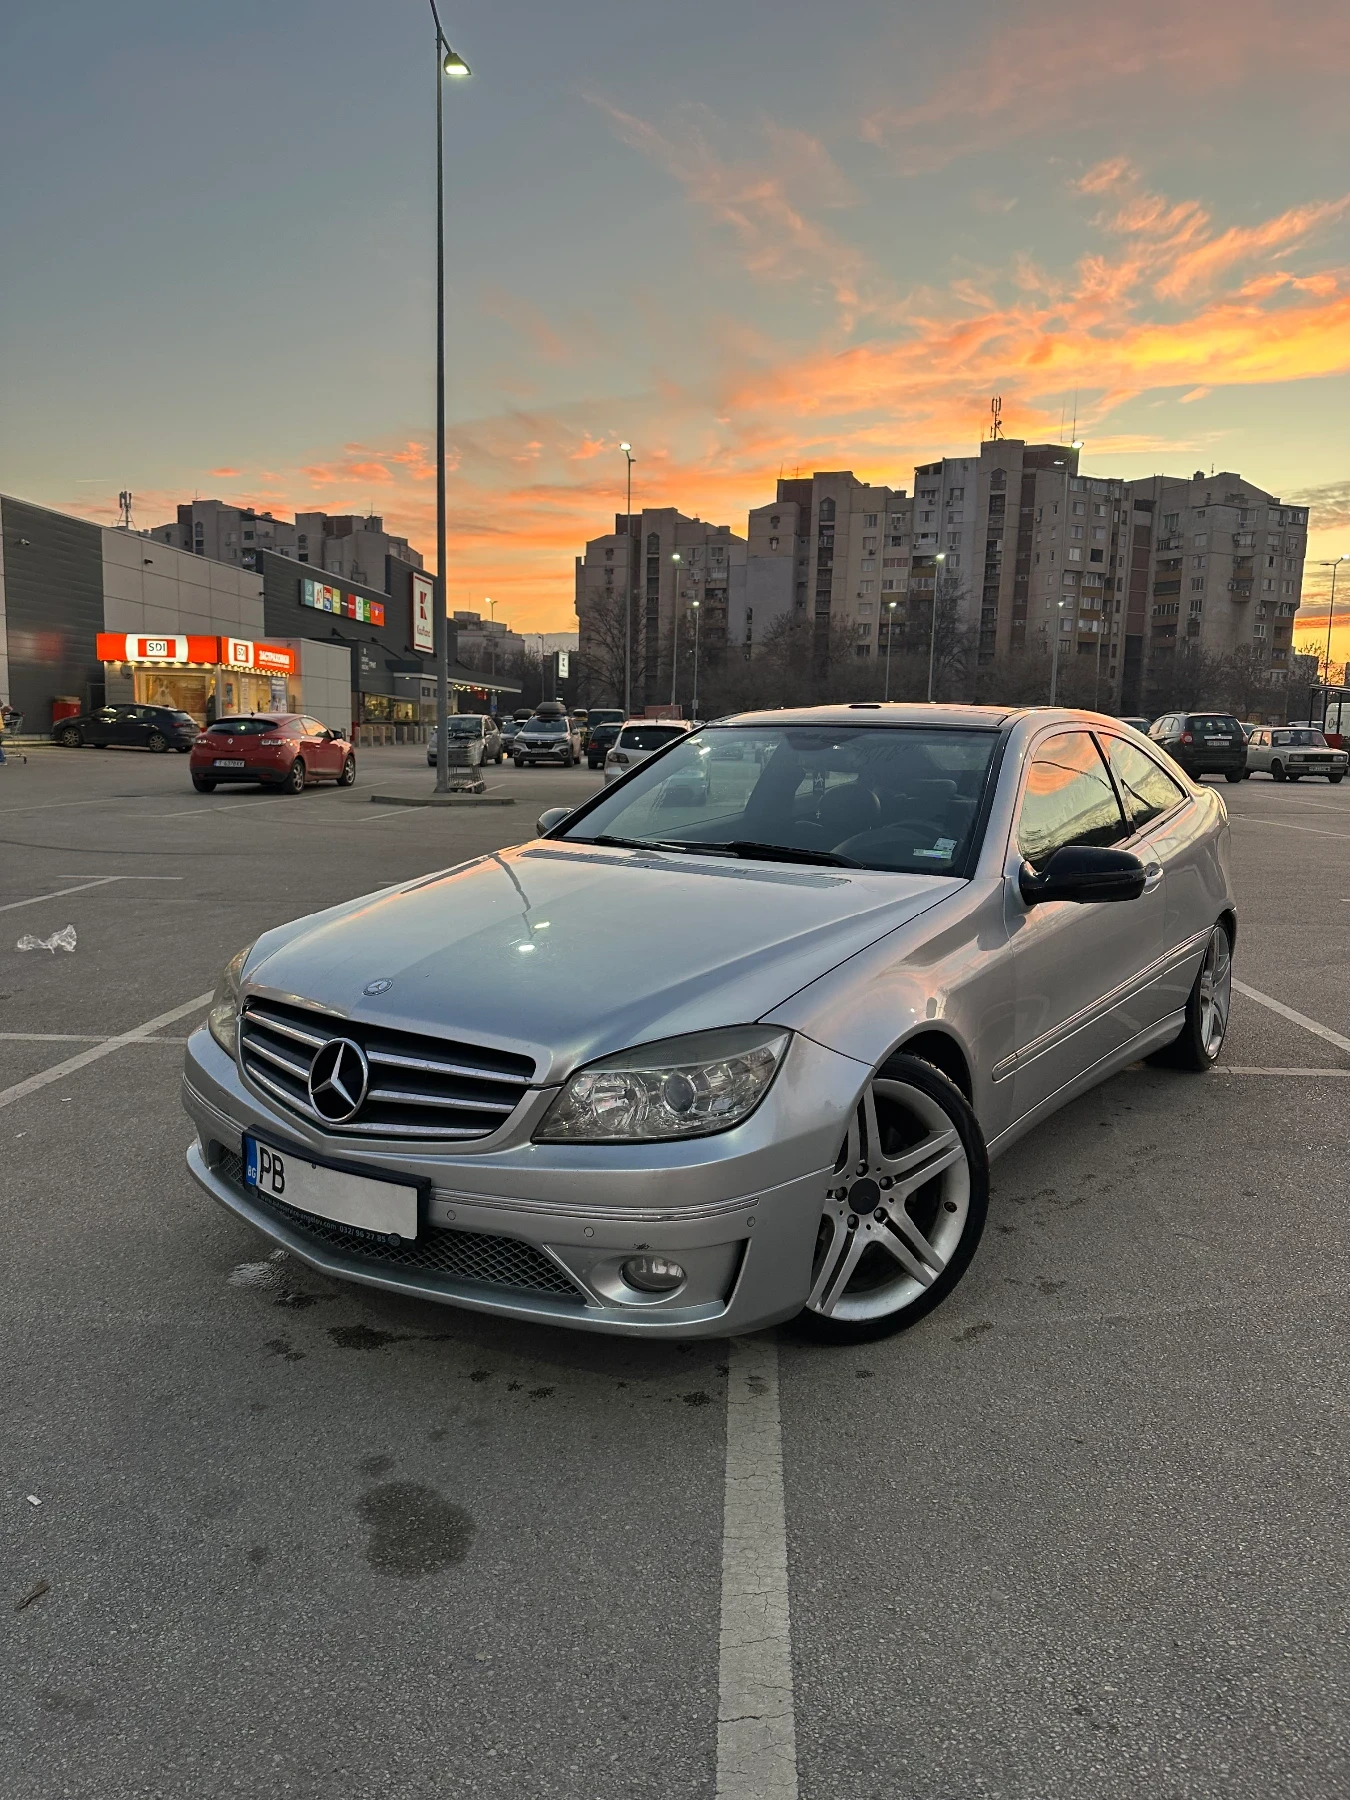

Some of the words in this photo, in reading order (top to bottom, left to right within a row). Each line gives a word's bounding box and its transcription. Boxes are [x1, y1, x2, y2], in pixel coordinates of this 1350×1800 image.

[420, 591, 427, 620] K
[148, 642, 166, 652] SDI
[247, 1165, 257, 1178] BG
[259, 1146, 286, 1195] PB
[356, 1229, 365, 1238] 96
[366, 1232, 375, 1240] 27
